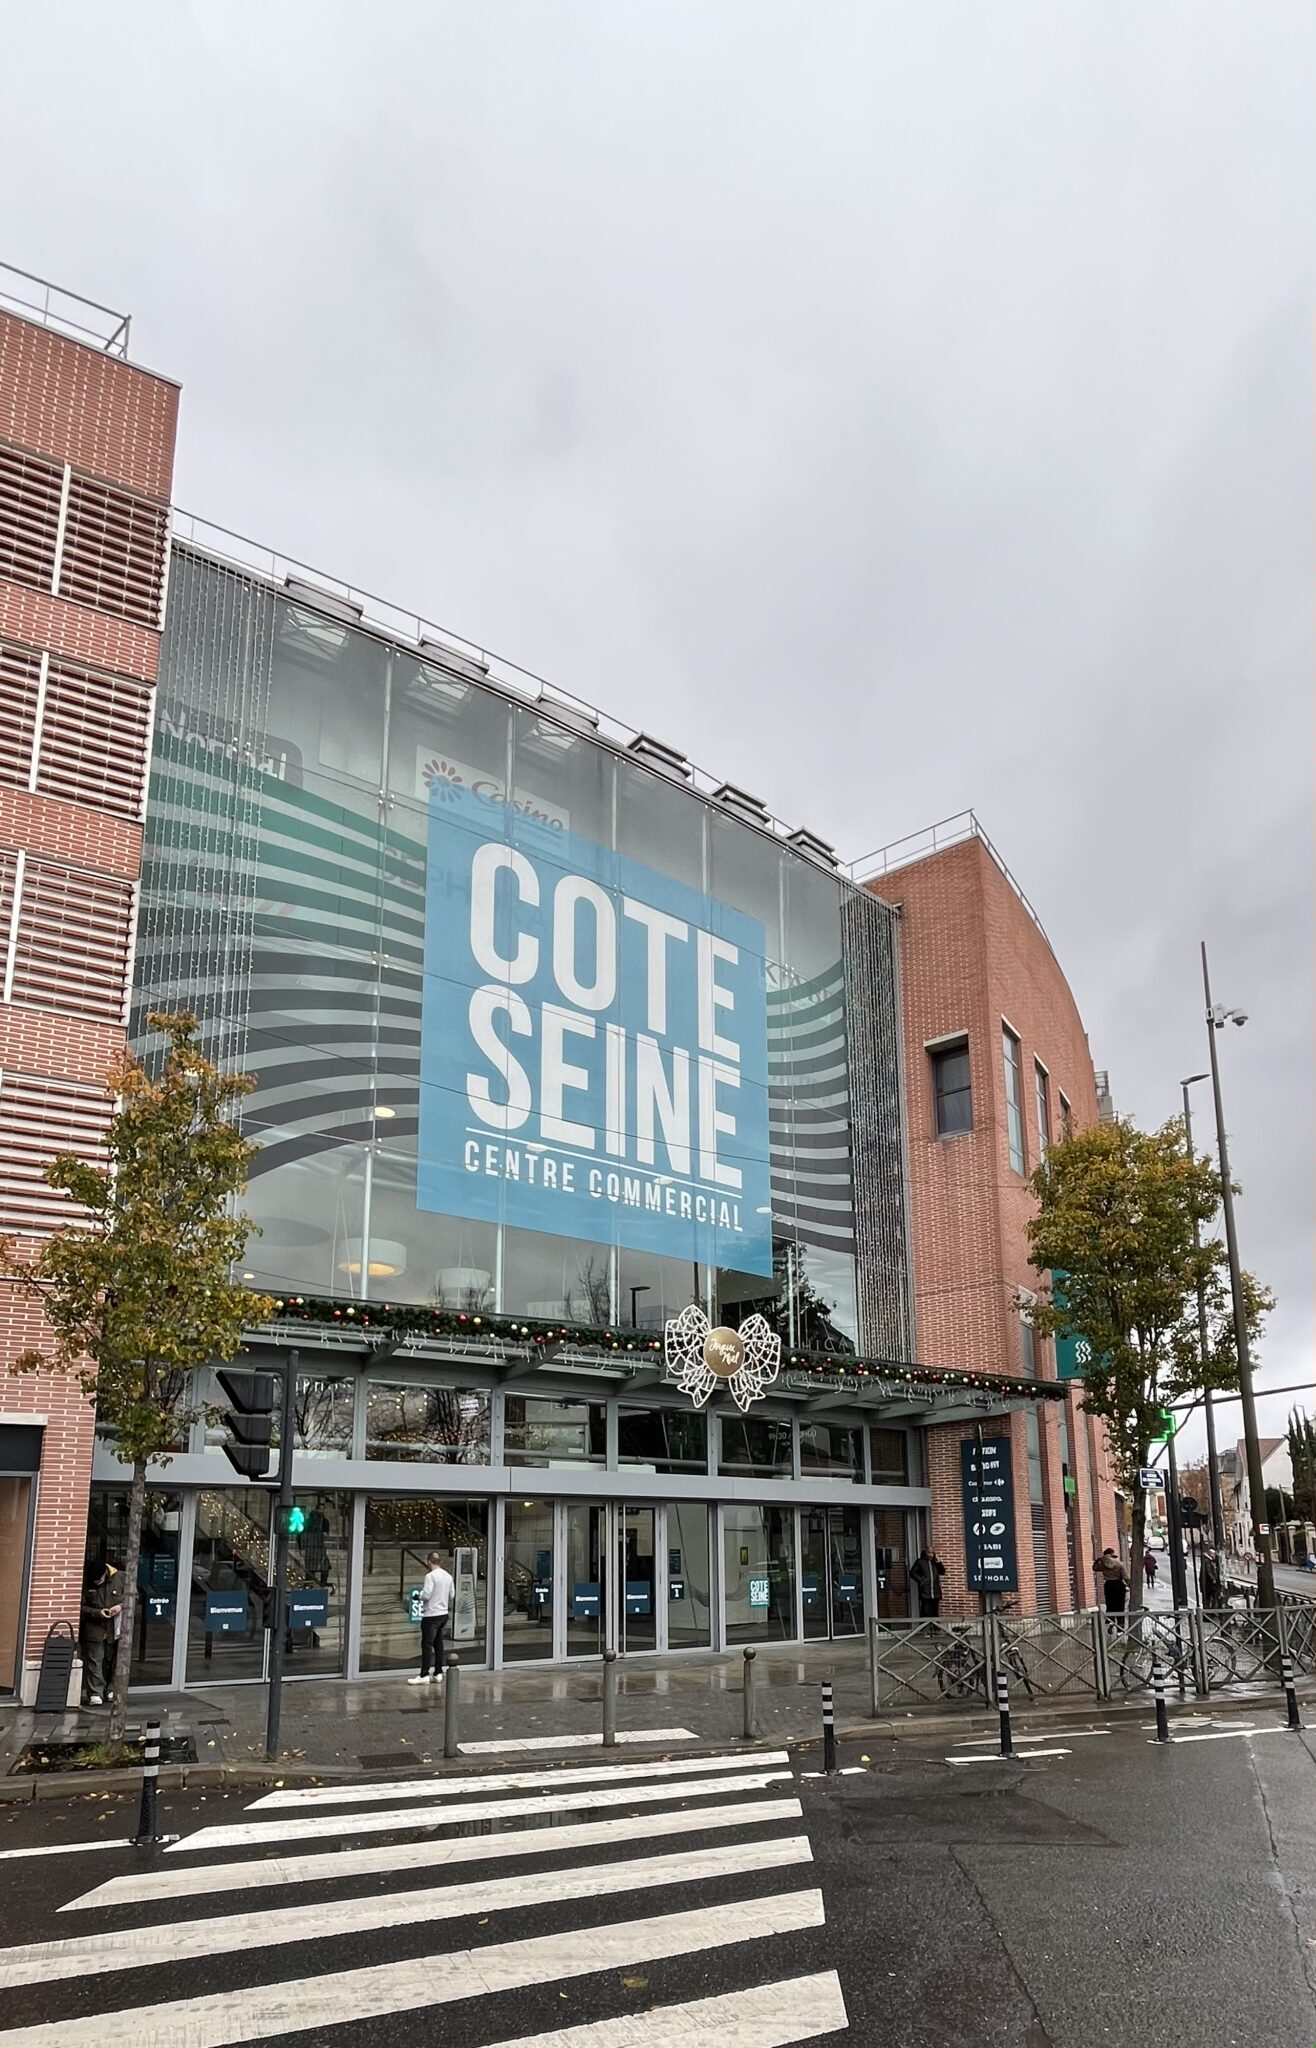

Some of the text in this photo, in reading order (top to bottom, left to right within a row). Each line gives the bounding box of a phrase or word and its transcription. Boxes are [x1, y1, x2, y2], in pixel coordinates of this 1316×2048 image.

[471, 780, 562, 831] Casino
[470, 842, 741, 1063] COTE
[466, 985, 743, 1189] SEINE
[464, 1140, 744, 1232] CENTRE COMMERCIAL
[155, 1604, 162, 1616] 1
[750, 1580, 769, 1591] COTE
[750, 1591, 769, 1602] SEINE
